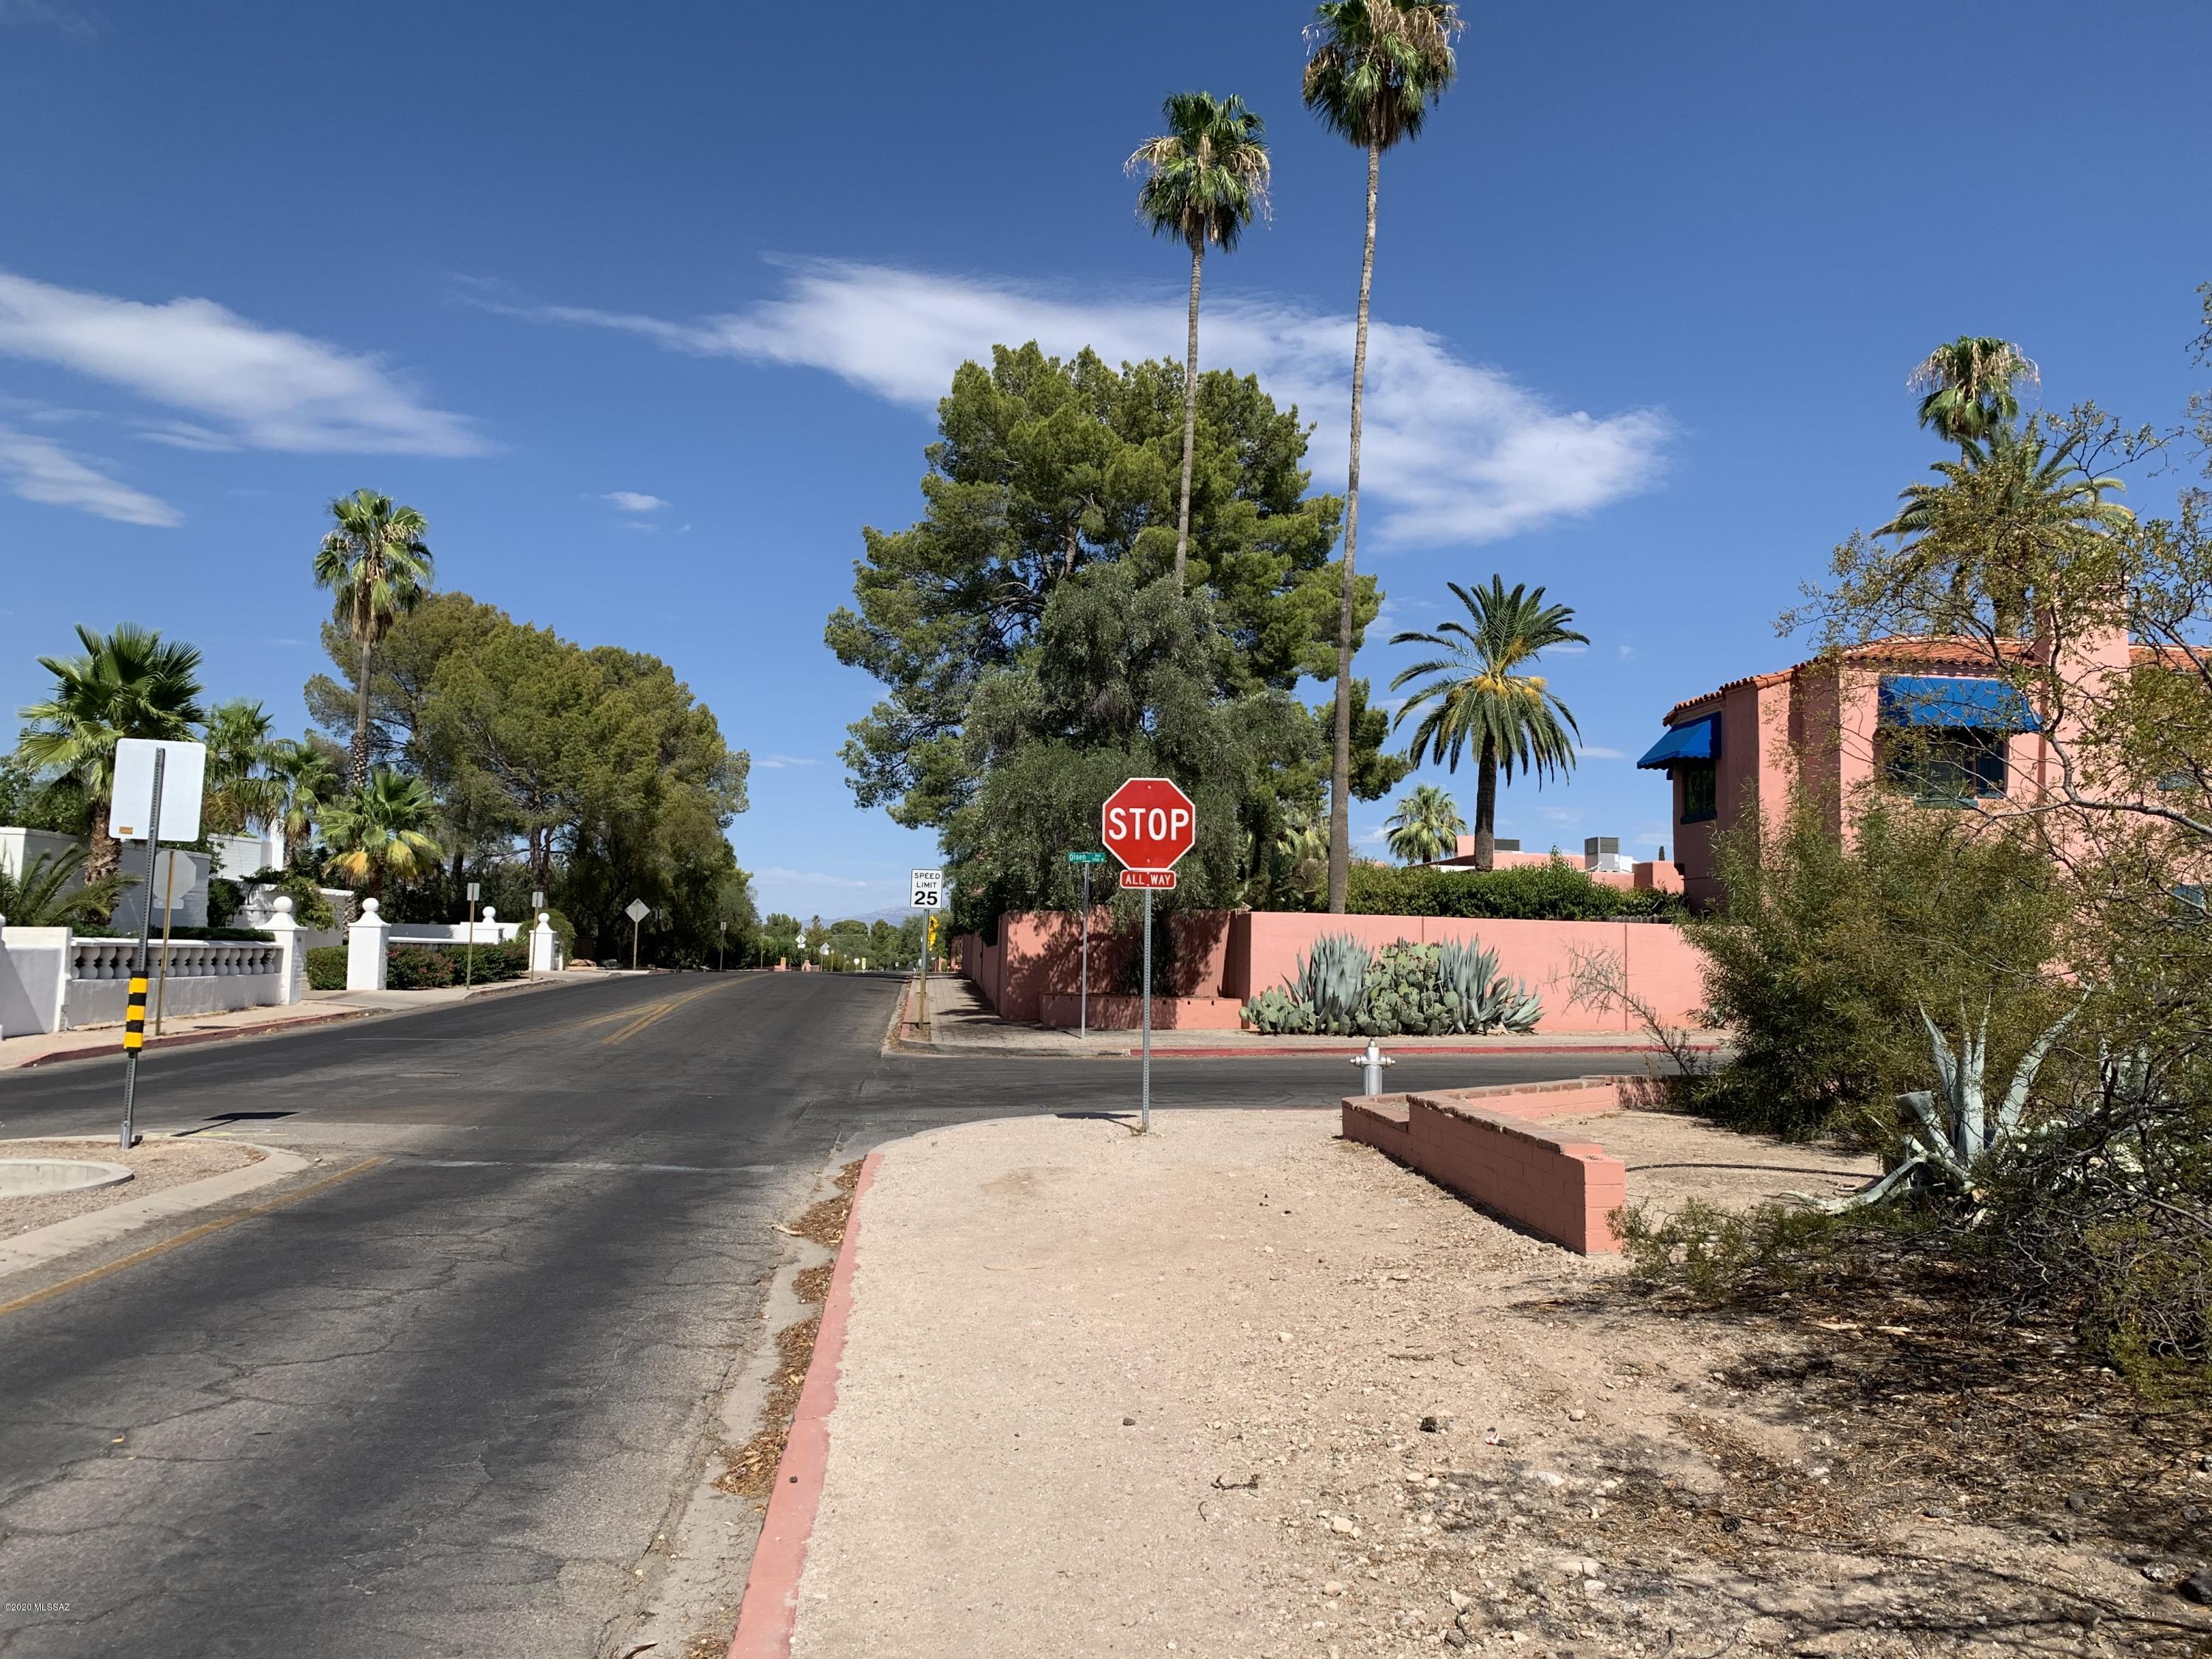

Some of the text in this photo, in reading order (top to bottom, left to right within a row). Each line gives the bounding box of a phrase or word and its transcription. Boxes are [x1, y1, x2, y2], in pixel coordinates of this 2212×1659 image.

[1108, 807, 1189, 841] STOP
[1124, 874, 1172, 886] ALL WAY
[914, 891, 938, 905] 25
